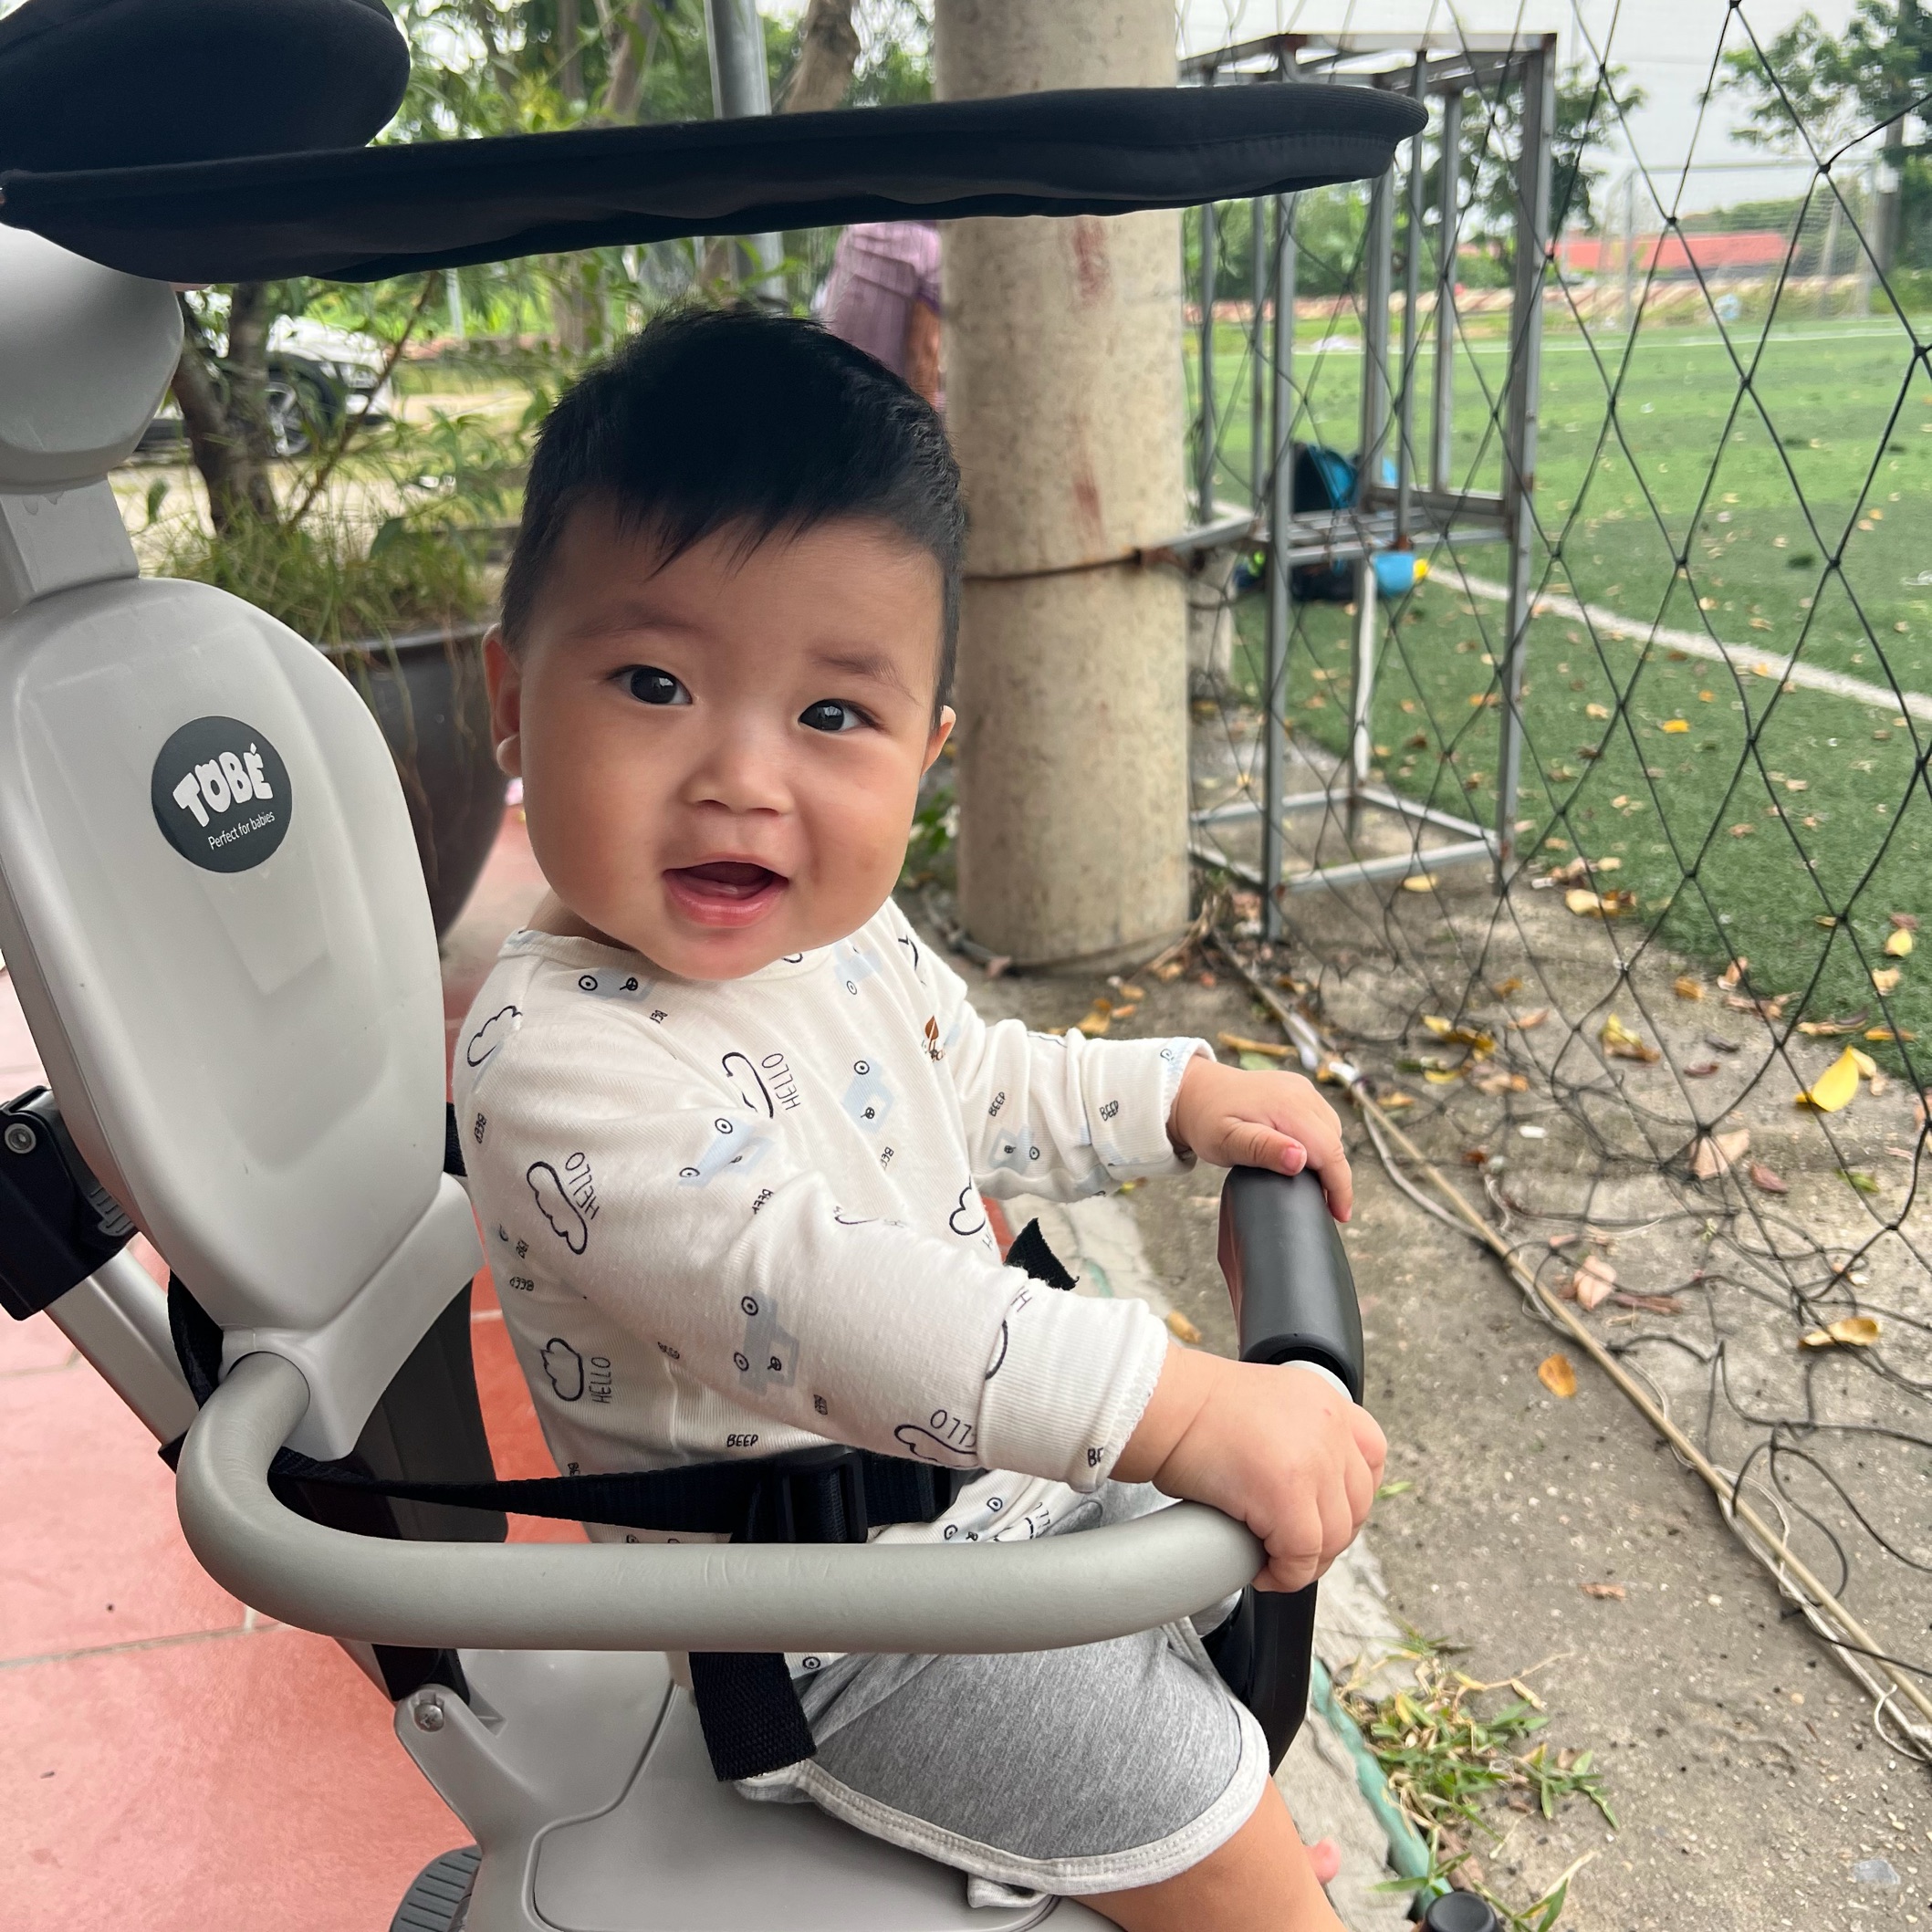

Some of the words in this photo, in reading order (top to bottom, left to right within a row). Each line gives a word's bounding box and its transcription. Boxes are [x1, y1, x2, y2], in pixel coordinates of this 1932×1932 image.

[208, 828, 240, 851] Perfect
[238, 822, 251, 836] for
[250, 811, 276, 830] babies
[762, 1053, 801, 1111] HELLO
[988, 1091, 1006, 1117] BEEP
[474, 1112, 487, 1144] BEEP
[565, 1152, 600, 1219] HELLO
[509, 1277, 535, 1292] BEEP
[589, 1356, 612, 1404] HELLO
[726, 1434, 758, 1448] BEEP
